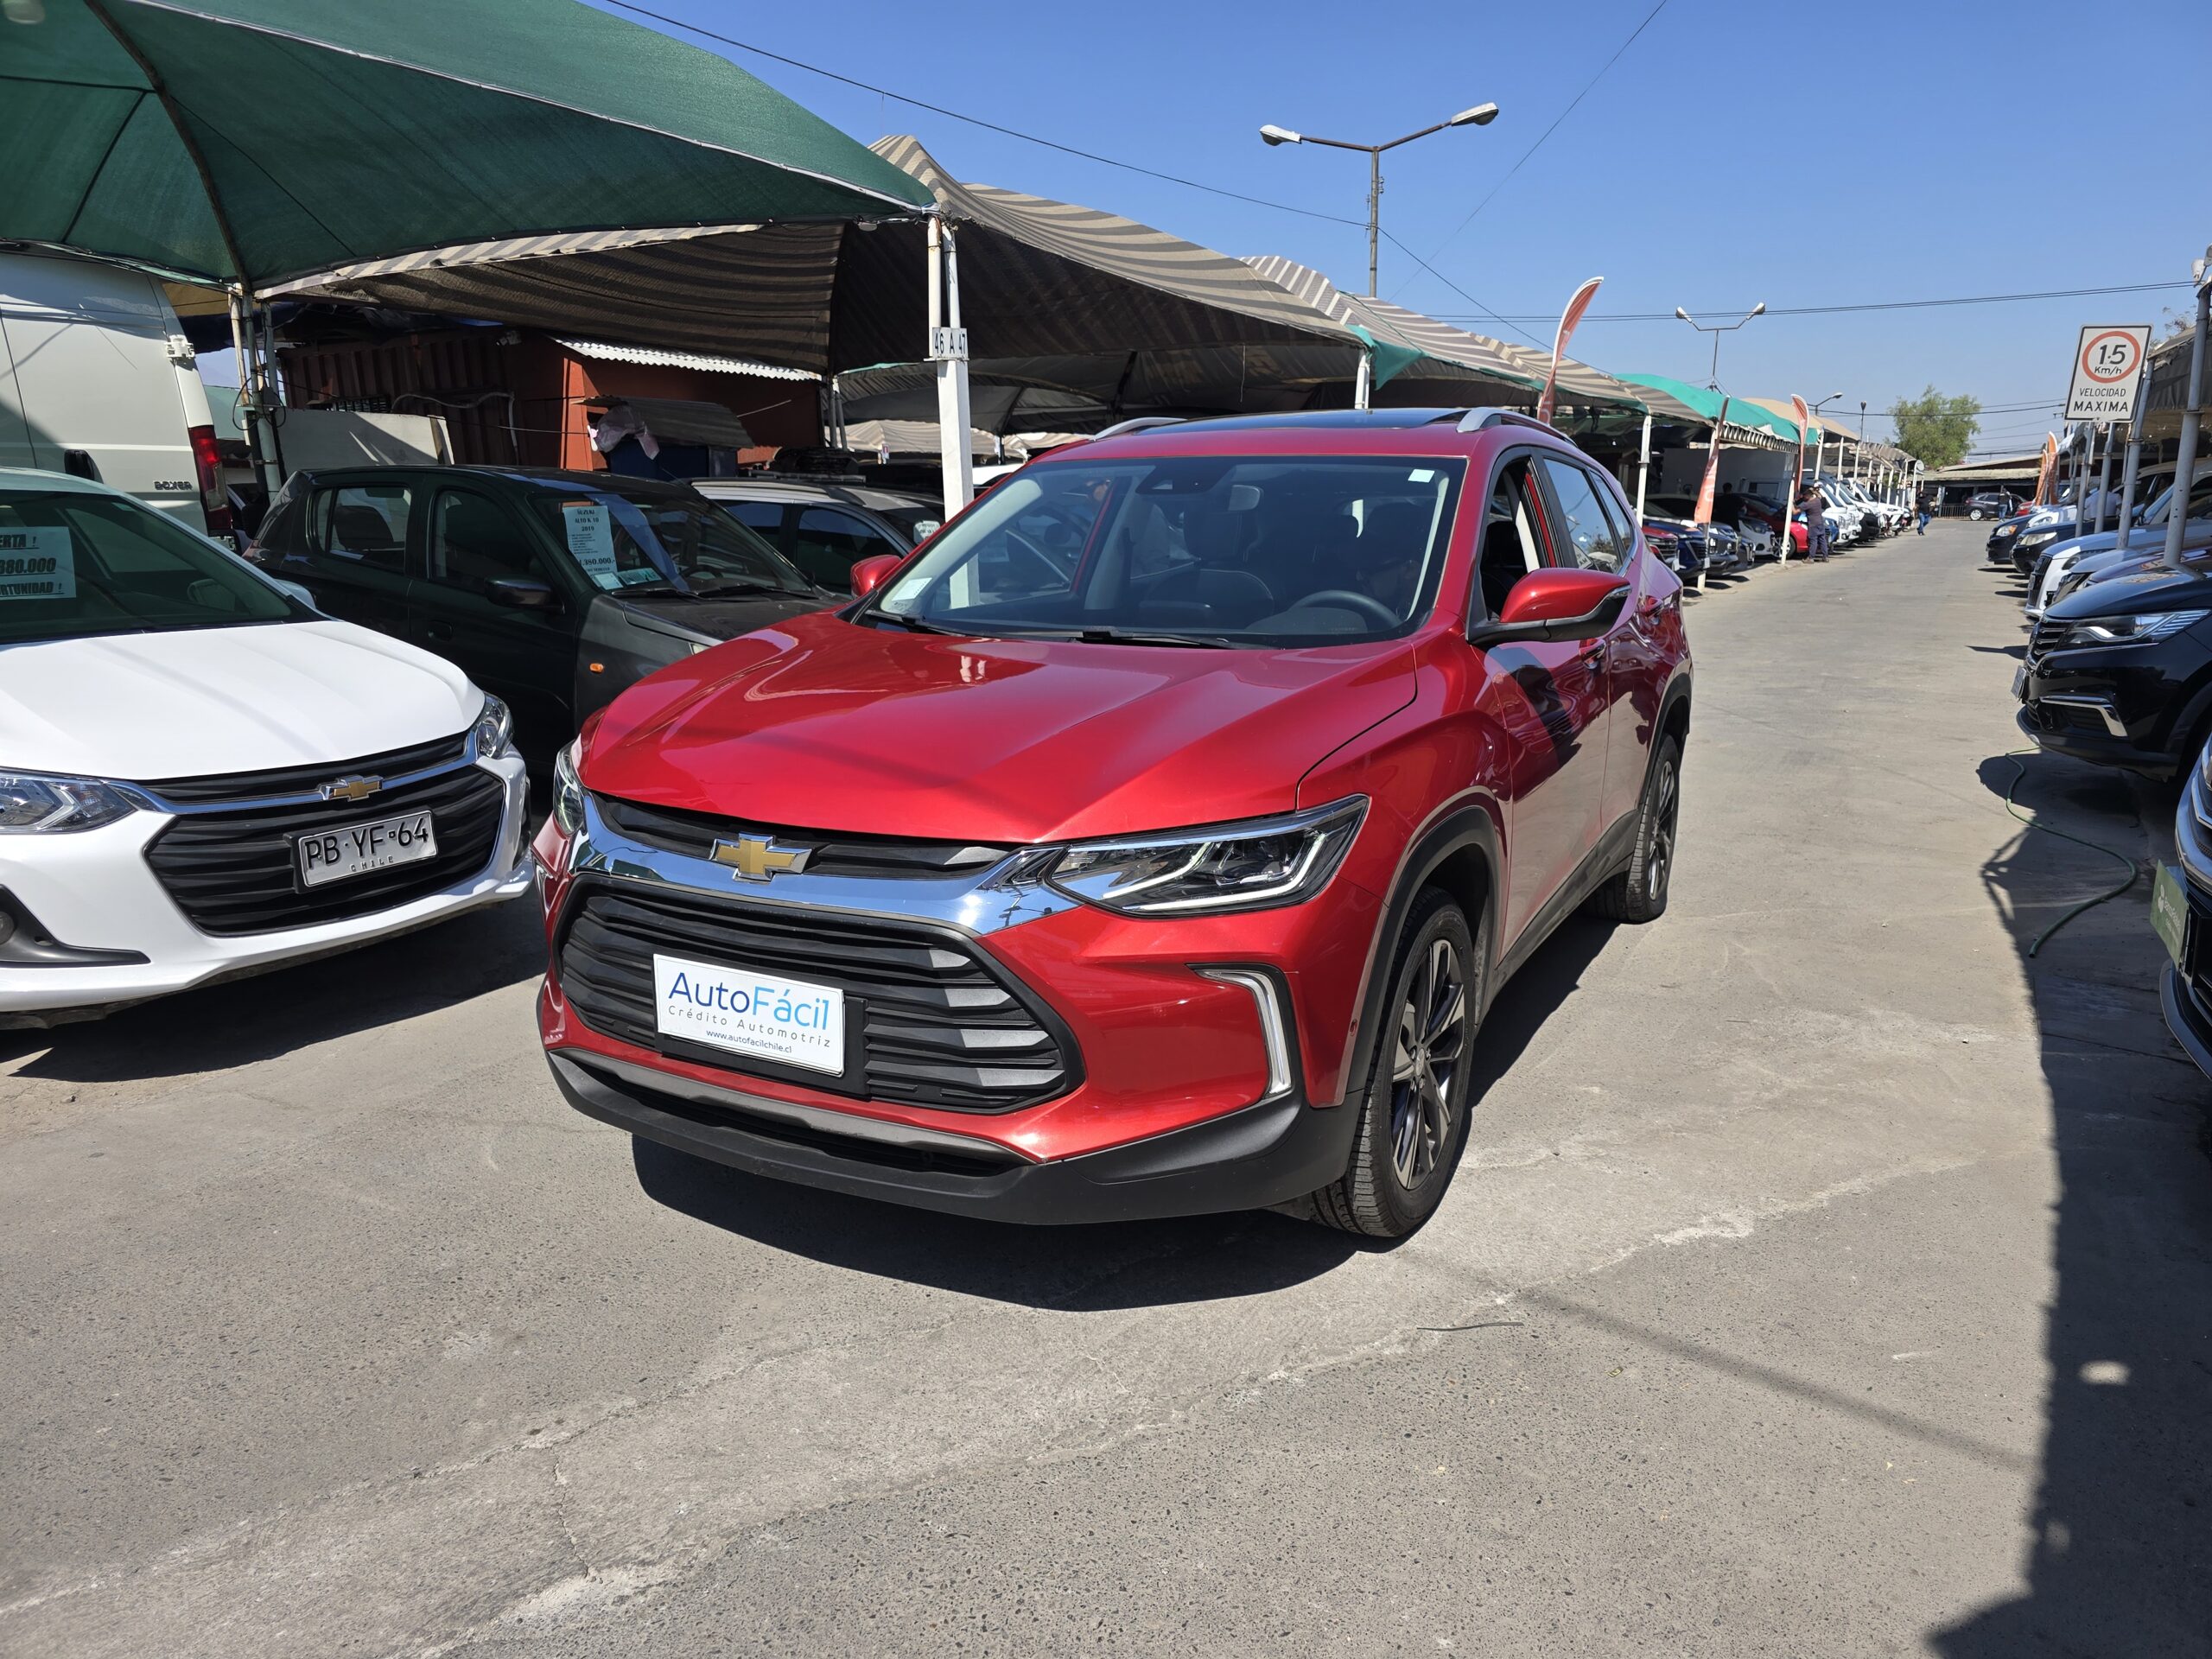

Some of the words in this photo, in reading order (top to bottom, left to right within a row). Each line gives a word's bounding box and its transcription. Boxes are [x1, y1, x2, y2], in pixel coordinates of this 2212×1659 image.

[935, 333, 944, 354] 46
[950, 332, 955, 354] A
[958, 333, 966, 354] 47
[2094, 365, 2122, 375] Km/h
[2079, 388, 2126, 397] VELOCIDAD
[2073, 400, 2128, 412] MAXIMA
[154, 481, 193, 491] BOXER
[668, 971, 830, 1031] AutoFácil
[668, 1005, 728, 1027] Crédito
[736, 1019, 830, 1048] Automotriz
[706, 1029, 792, 1054] www.autofacilchile.cl
